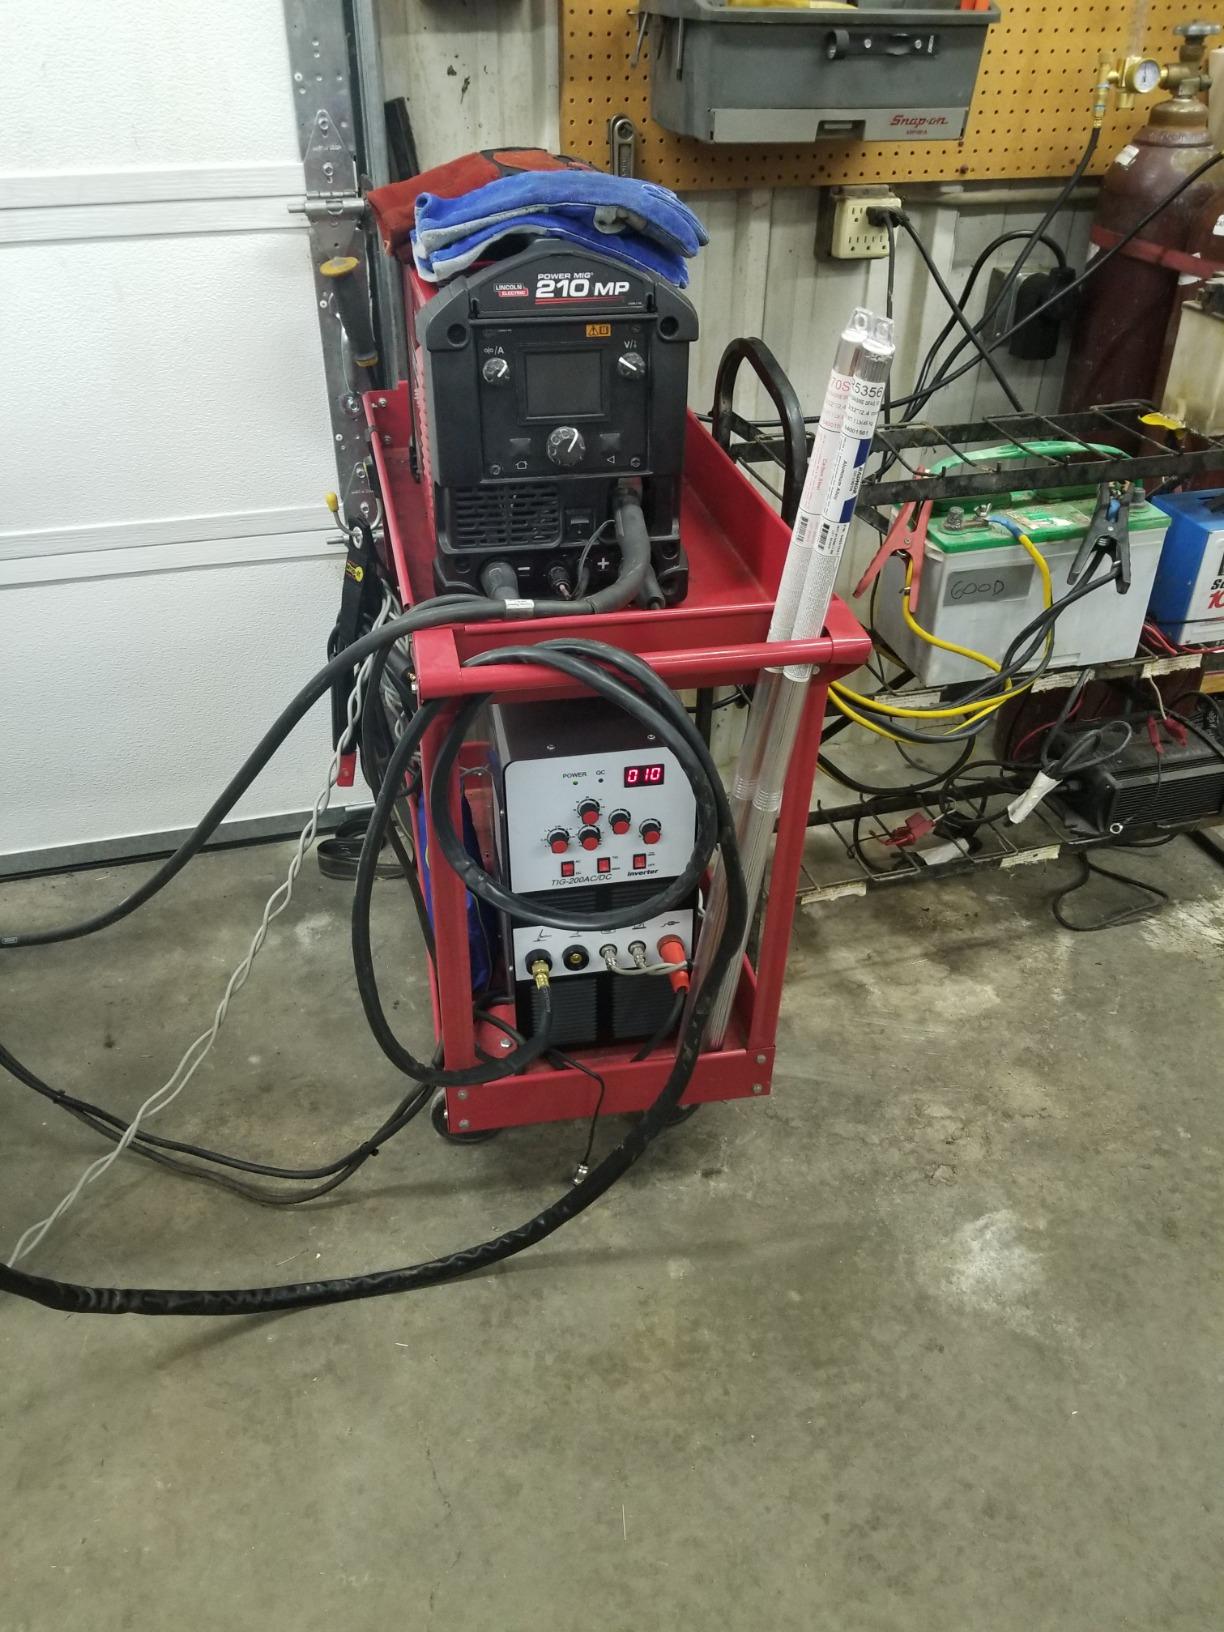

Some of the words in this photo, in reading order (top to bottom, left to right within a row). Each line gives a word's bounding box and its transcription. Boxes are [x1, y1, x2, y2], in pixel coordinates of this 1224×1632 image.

[890, 115, 949, 128] Snap-on
[536, 279, 590, 298] 210
[593, 282, 630, 296] MP
[951, 580, 1005, 599] GOOD
[562, 771, 587, 779] POWER
[627, 767, 661, 782] 010
[551, 873, 613, 886] TIG-200AC/DC
